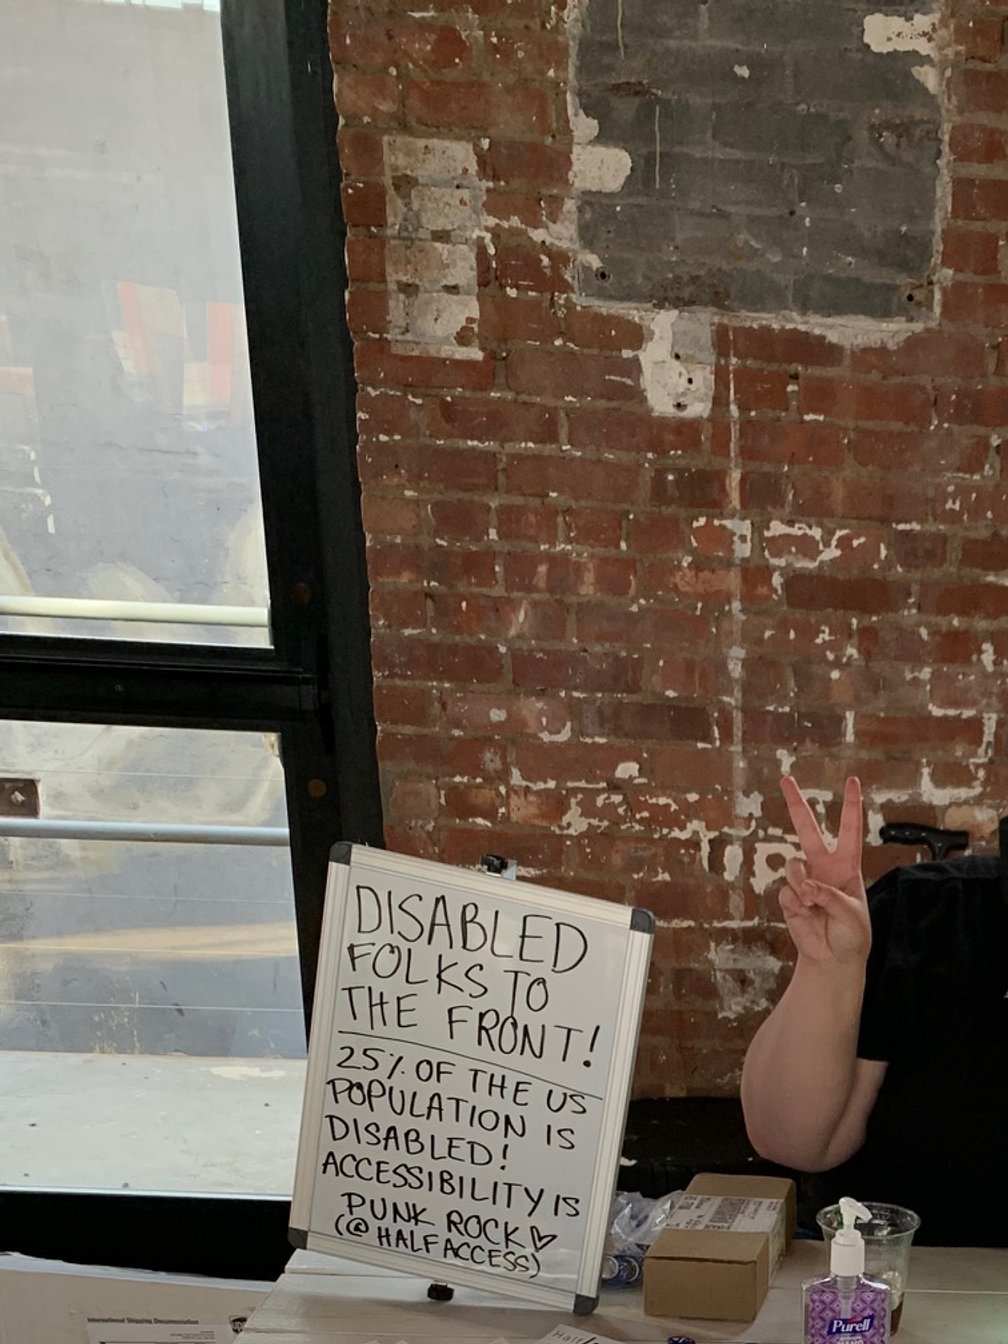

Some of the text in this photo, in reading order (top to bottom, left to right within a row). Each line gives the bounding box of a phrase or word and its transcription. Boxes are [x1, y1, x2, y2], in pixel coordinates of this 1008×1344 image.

[356, 885, 588, 974] DISABLED
[347, 942, 550, 1018] FOLKS TO
[342, 985, 601, 1068] THE FRONT!
[326, 1077, 576, 1150] POPULATION IS
[337, 1046, 589, 1115] 25% OF THE US
[324, 1114, 508, 1171] DISABLED!
[321, 1151, 581, 1219] ACCESSIBILITY IS
[341, 1192, 527, 1249] PUNK ROCK
[832, 1318, 871, 1333] Purell
